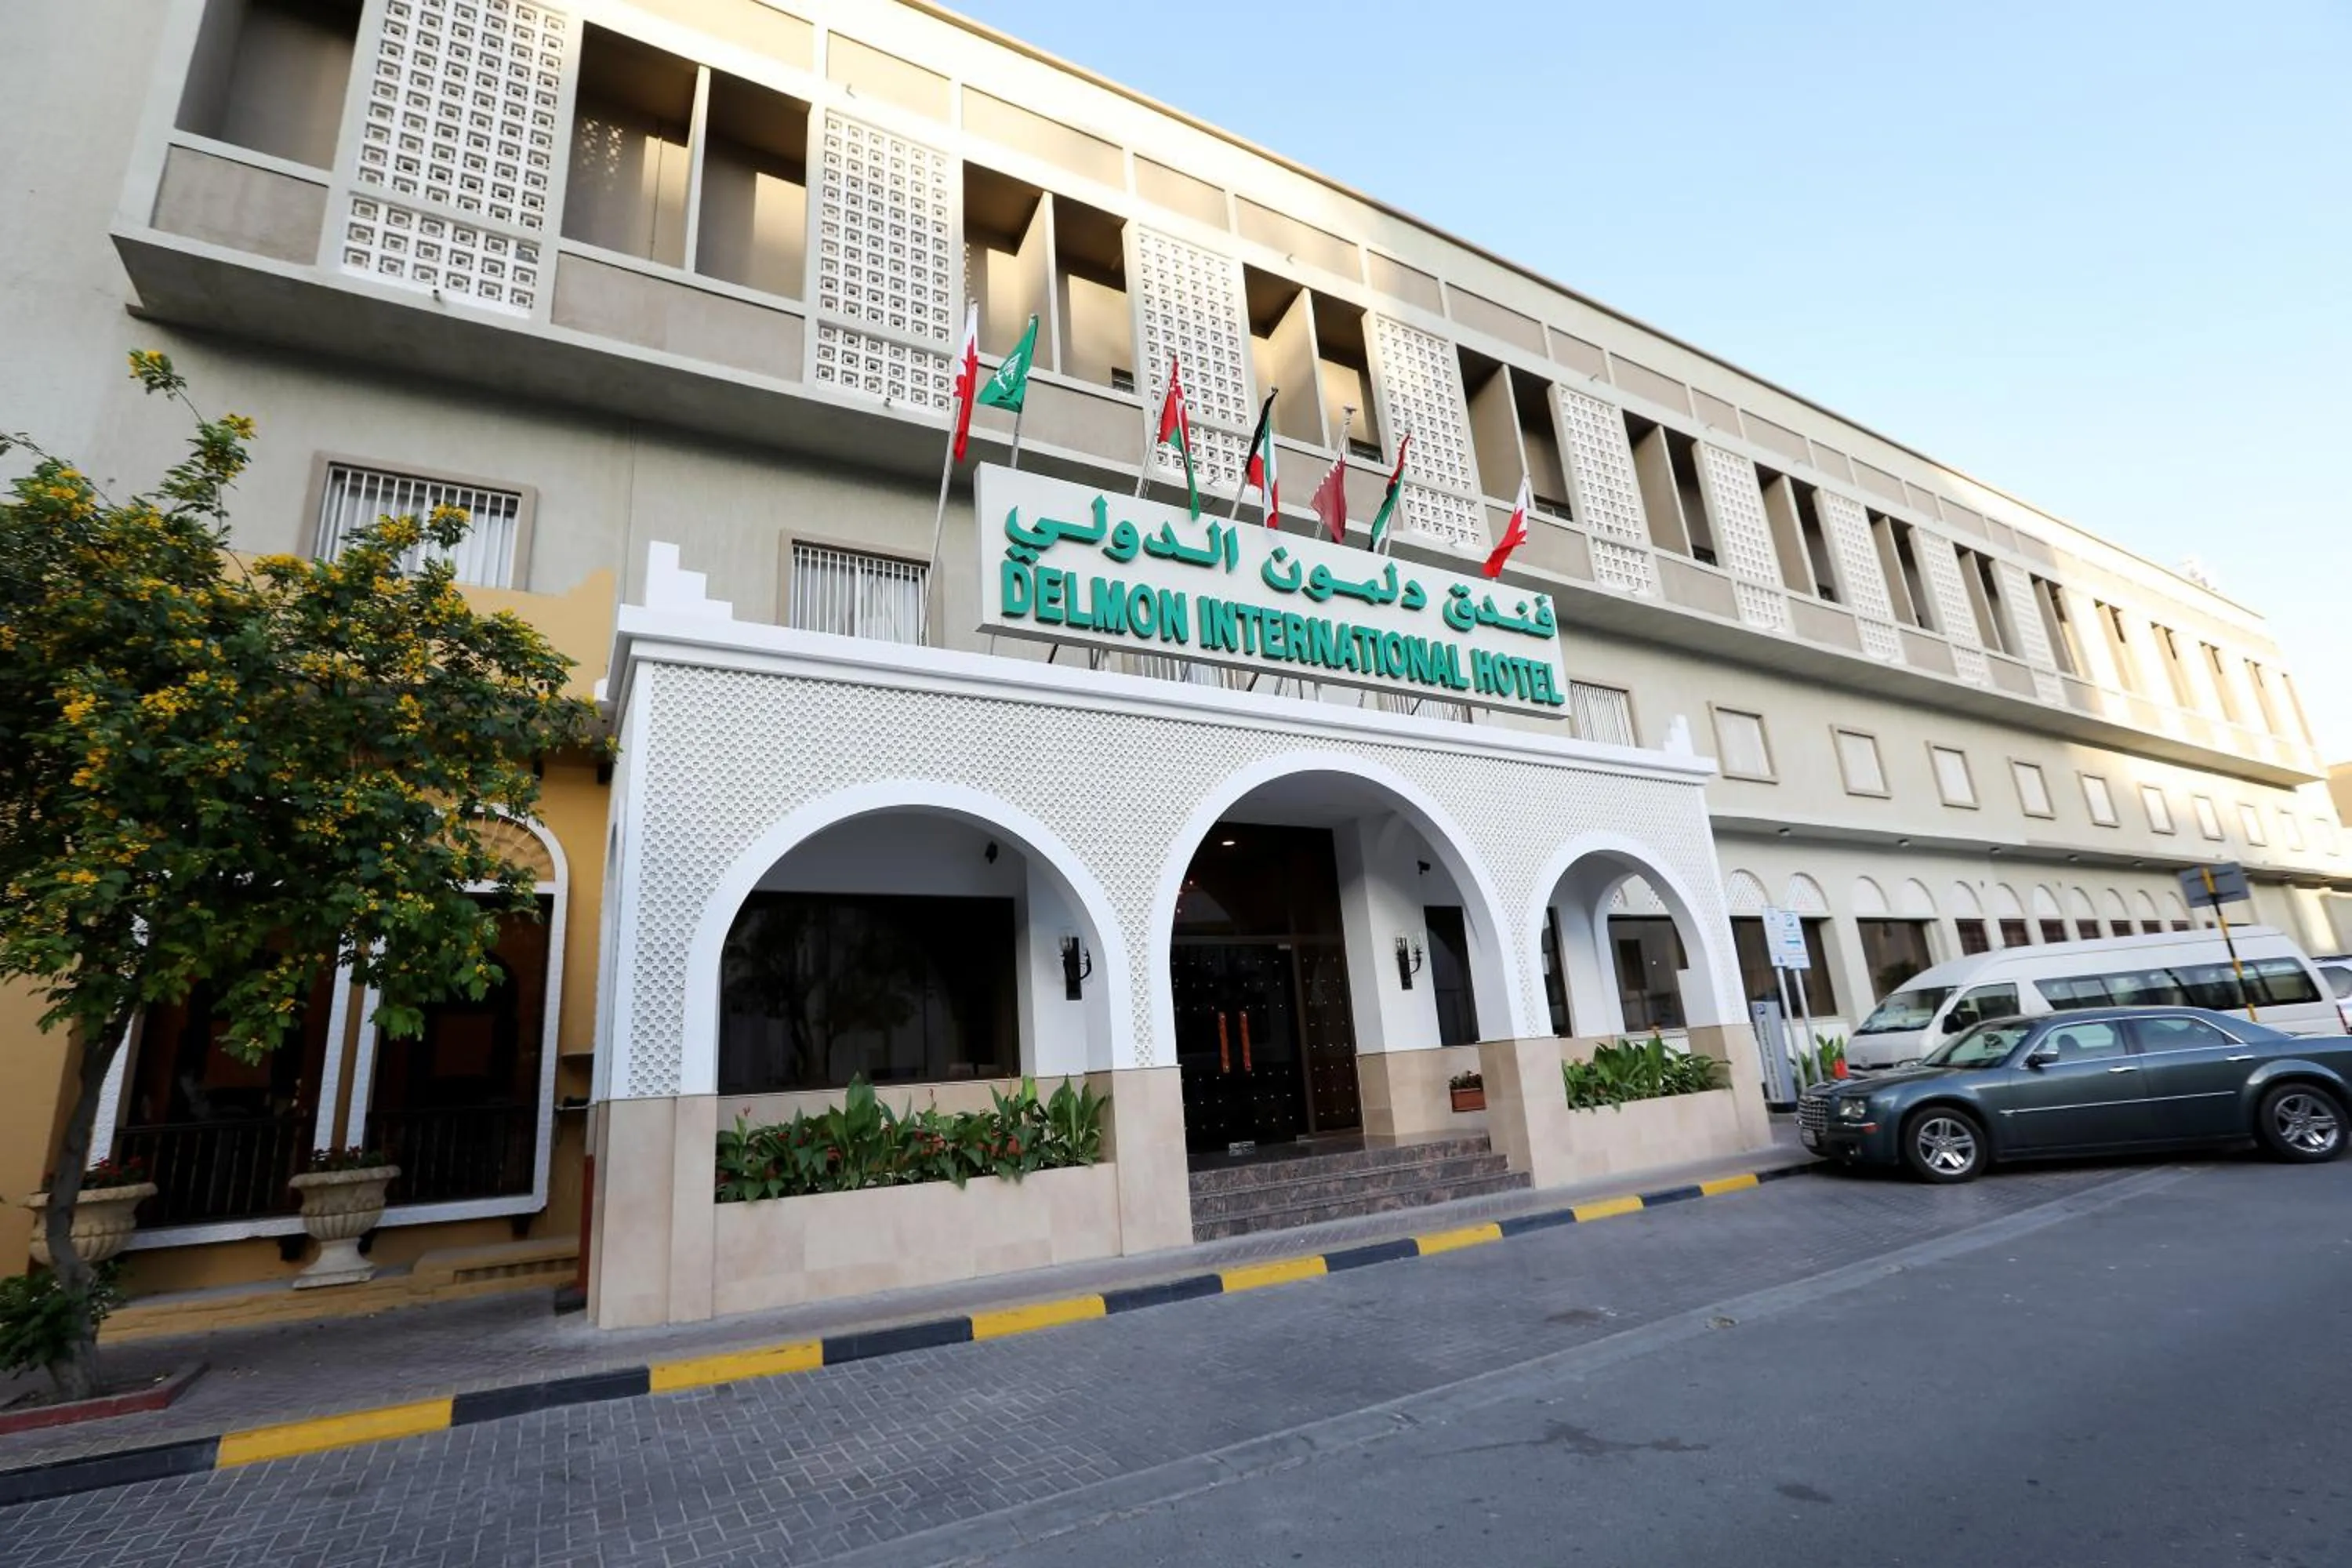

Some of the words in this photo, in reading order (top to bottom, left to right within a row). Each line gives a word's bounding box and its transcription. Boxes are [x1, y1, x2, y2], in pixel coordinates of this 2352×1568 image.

[1004, 494, 1240, 574] الدولي
[1261, 546, 1428, 611] دلمون
[1443, 582, 1557, 640] فندق
[1000, 559, 1189, 644] DELMON
[1196, 594, 1471, 691] INTERNATIONAL
[1470, 648, 1566, 707] HOTEL
